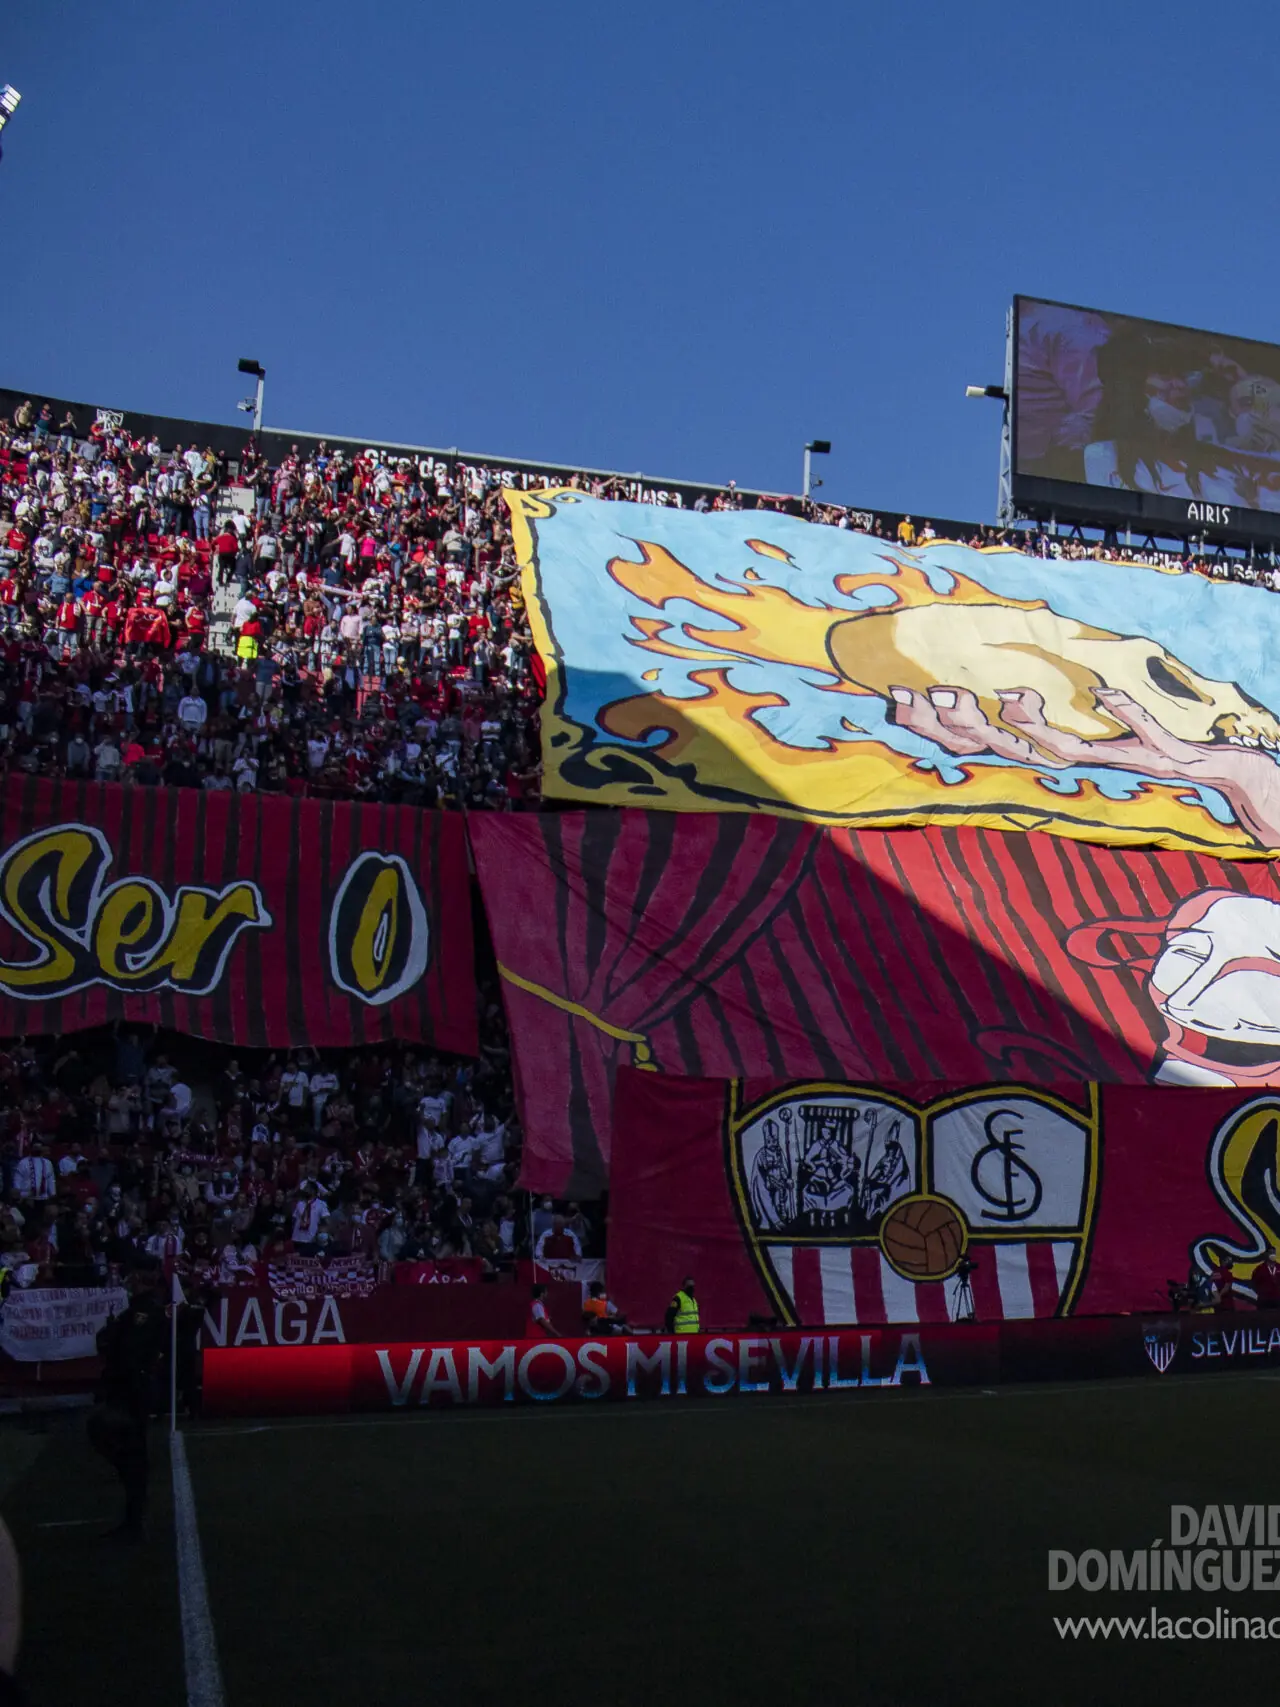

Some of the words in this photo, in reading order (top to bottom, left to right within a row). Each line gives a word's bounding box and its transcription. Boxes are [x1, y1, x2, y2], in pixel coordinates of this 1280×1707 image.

[1187, 501, 1231, 525] AIRIS
[0, 823, 272, 1000] Ser
[197, 1297, 346, 1349] NAGA
[375, 1341, 608, 1405] VAMOS
[625, 1339, 688, 1397] MI
[703, 1332, 932, 1395] SEVILLA
